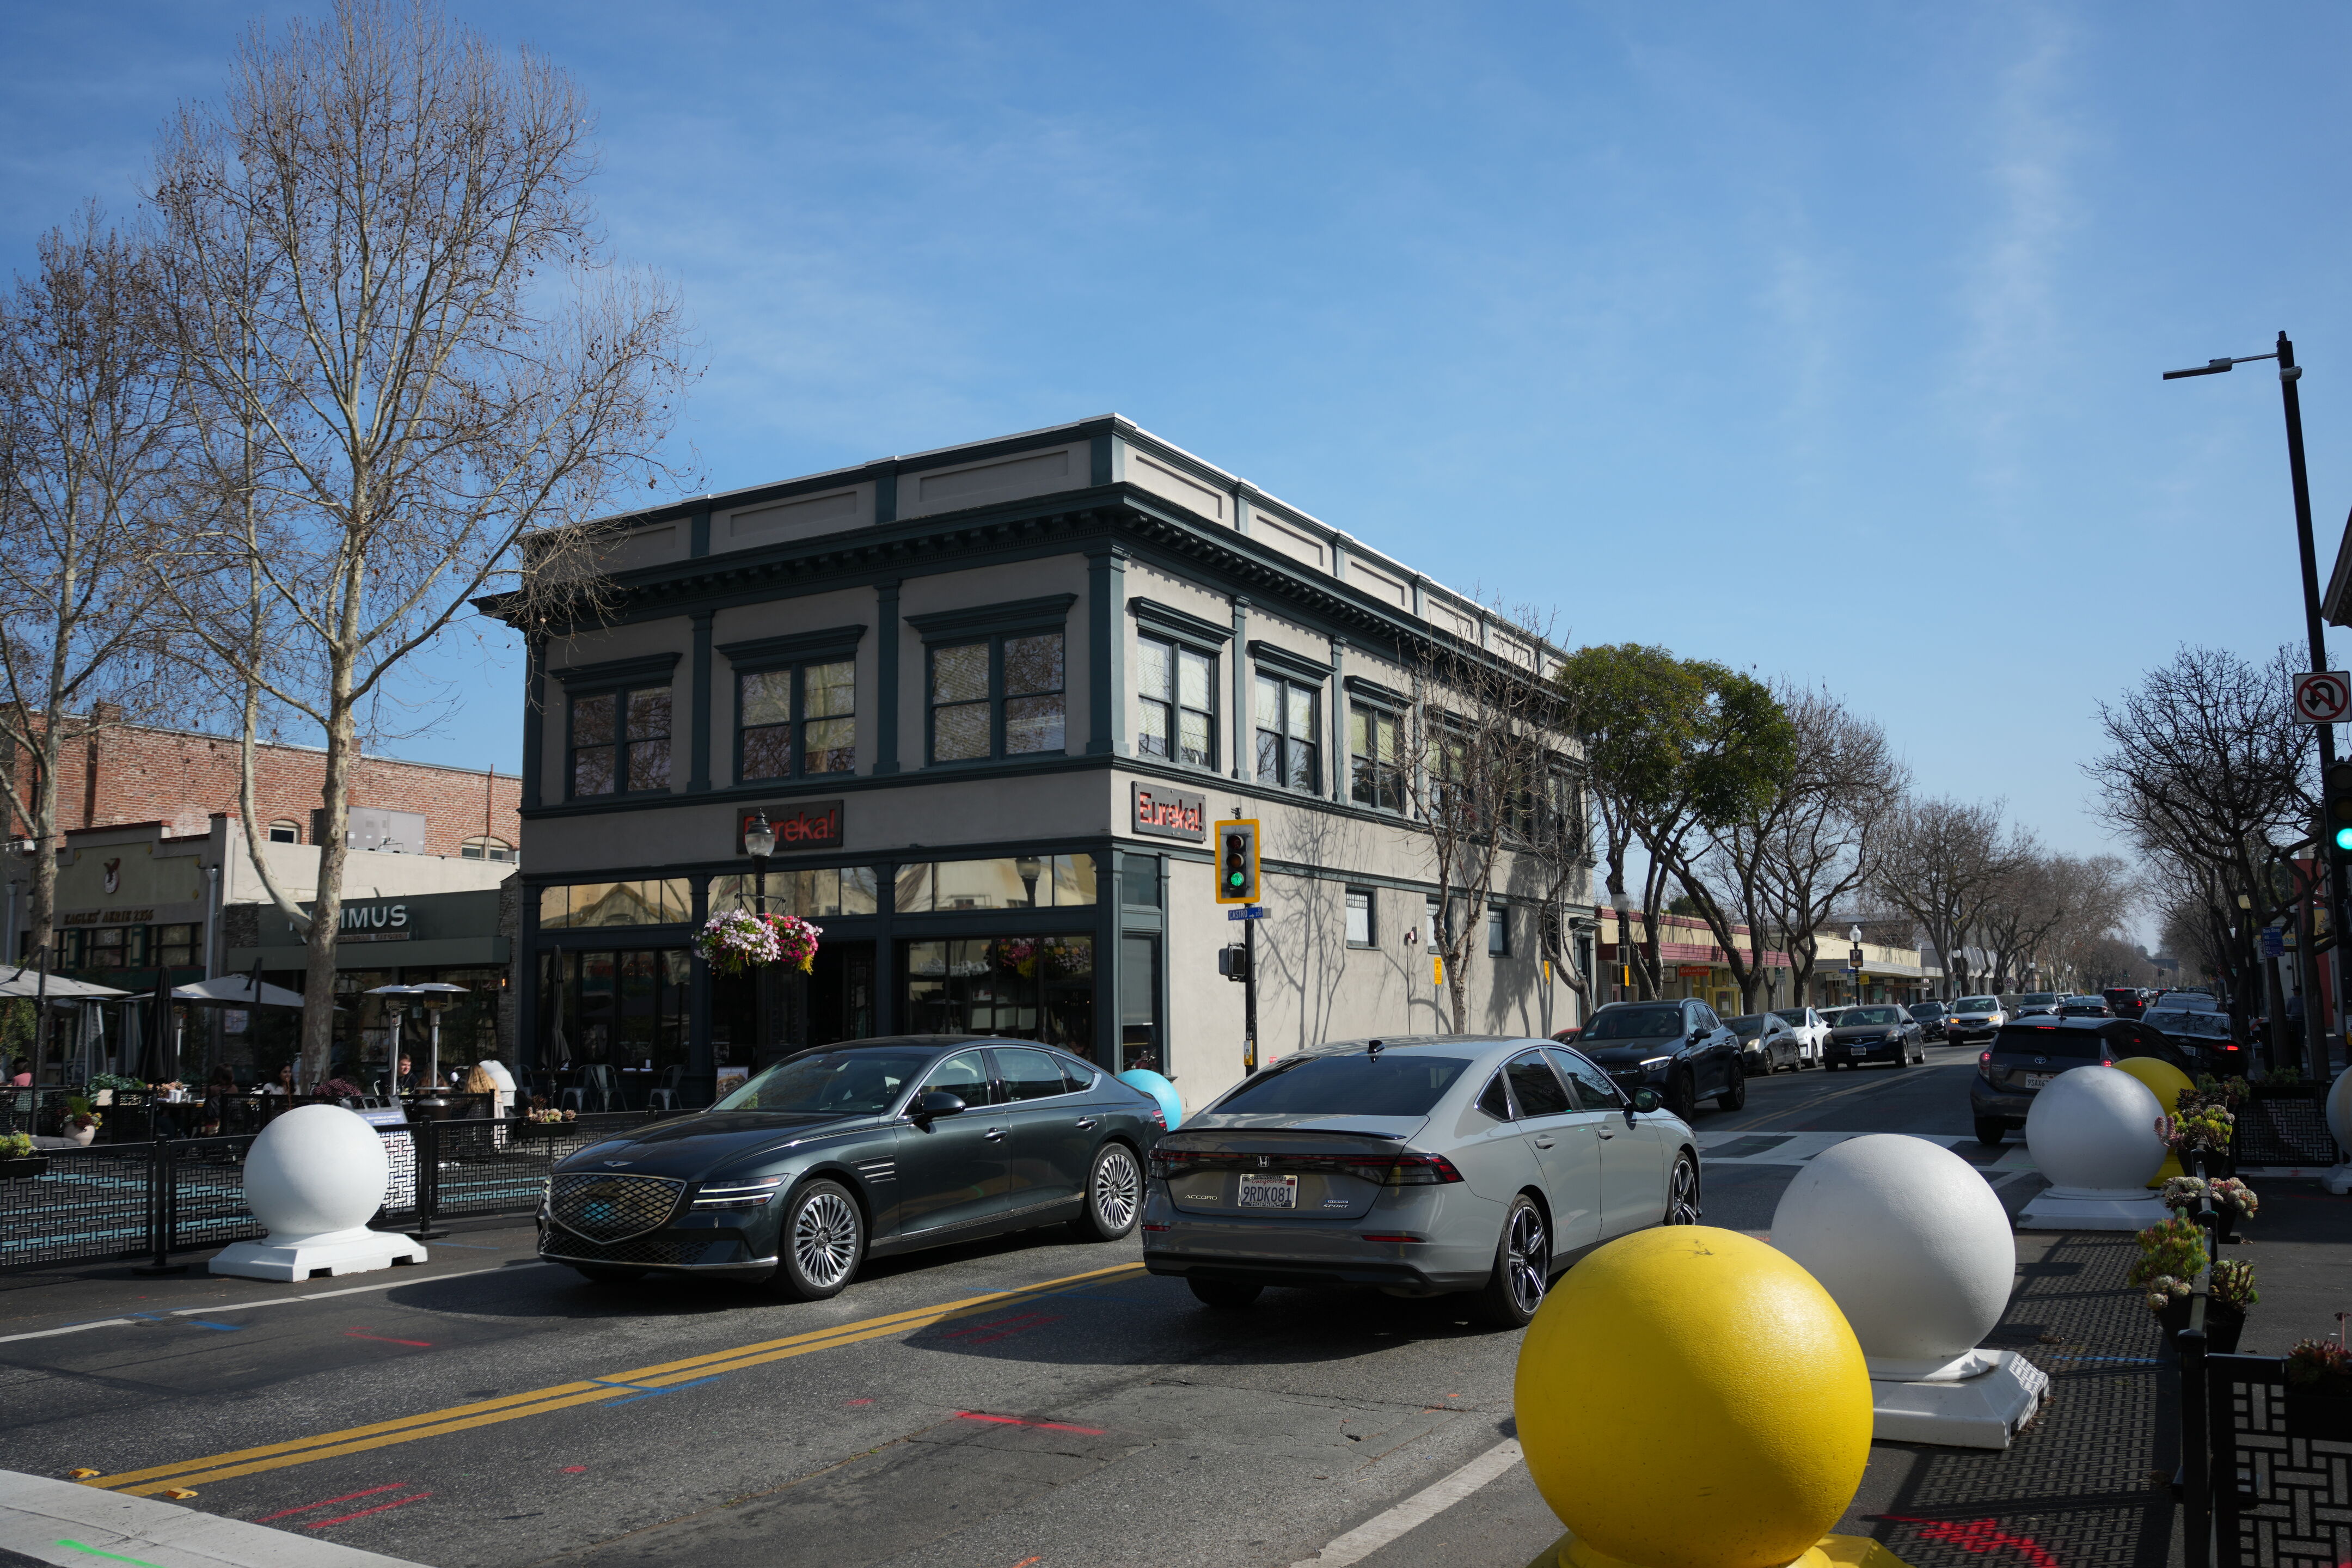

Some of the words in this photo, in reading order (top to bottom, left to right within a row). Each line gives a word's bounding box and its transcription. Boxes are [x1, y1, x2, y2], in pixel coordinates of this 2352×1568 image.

[1140, 792, 1202, 831] Eureka!
[102, 911, 132, 923] AERIE
[133, 910, 154, 922] 2356
[1229, 910, 1248, 919] CASTRO
[103, 932, 115, 944] 181
[1852, 951, 1859, 960] P
[1242, 1186, 1291, 1203] 9RDK081
